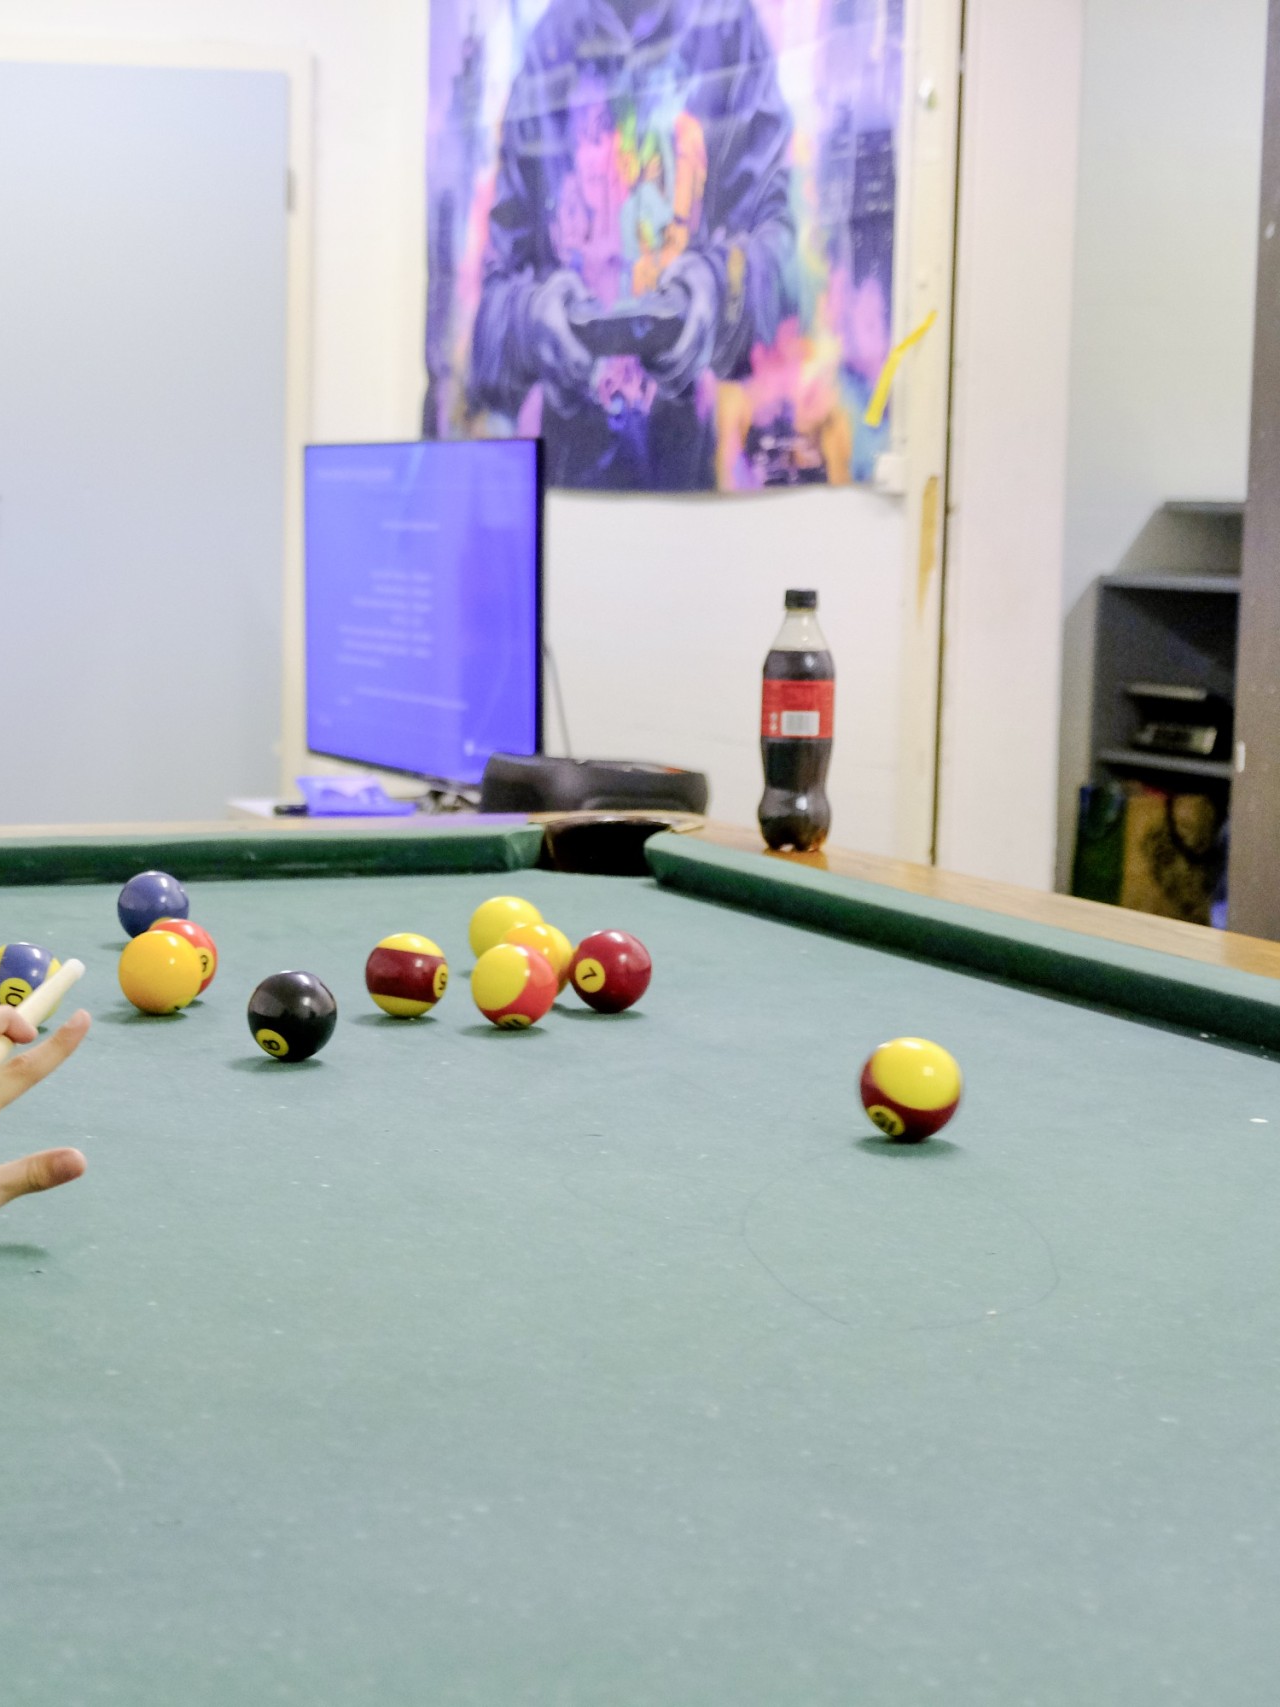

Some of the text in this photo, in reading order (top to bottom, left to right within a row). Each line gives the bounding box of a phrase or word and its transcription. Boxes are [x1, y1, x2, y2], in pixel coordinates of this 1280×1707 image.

[581, 966, 597, 981] 7
[5, 986, 26, 1006] 10
[262, 1039, 280, 1051] 8
